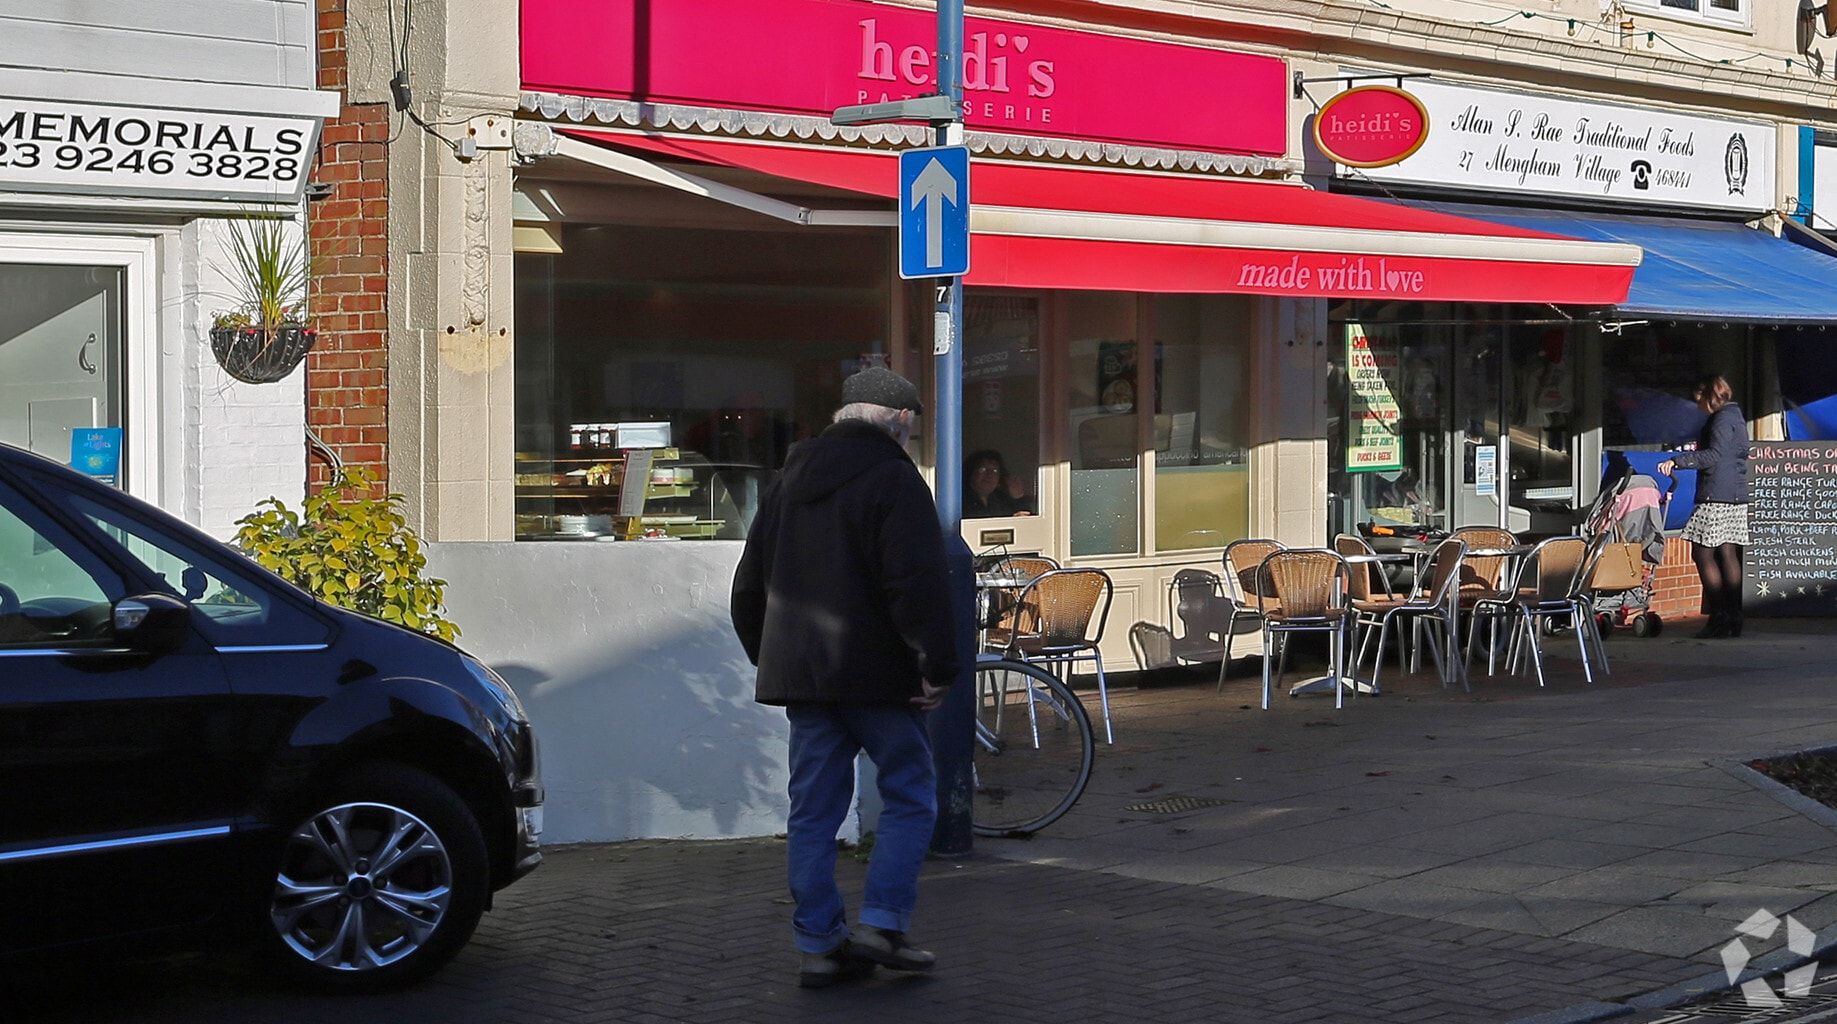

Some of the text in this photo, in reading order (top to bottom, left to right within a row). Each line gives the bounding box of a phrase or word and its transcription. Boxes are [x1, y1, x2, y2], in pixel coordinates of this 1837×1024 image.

[857, 19, 1055, 98] hedi's
[1330, 112, 1412, 134] heidi's
[1451, 104, 1494, 135] Alan
[1531, 112, 1563, 142] Rae
[1573, 117, 1653, 152] Traditional
[1658, 127, 1695, 157] Foods
[54, 144, 175, 175] 9246
[186, 153, 298, 181] 3828
[1459, 150, 1474, 172] 27
[1486, 143, 1562, 186] Mengham
[1573, 153, 1621, 194] Village
[1237, 255, 1311, 290] made
[1317, 257, 1373, 291] with
[936, 285, 947, 302] 7
[1352, 355, 1360, 367] IS
[1748, 446, 1820, 460] CHRISTMAS
[1755, 463, 1780, 474] NOW
[1784, 462, 1819, 475] BEING
[1755, 477, 1778, 487] FREE
[1781, 477, 1813, 489] RANGE
[1755, 488, 1777, 498] FREE
[1781, 488, 1813, 500] RANGE
[1755, 499, 1778, 509] FREE
[1781, 499, 1811, 510] RANGE
[1755, 510, 1780, 520] FREE
[1781, 510, 1810, 520] RANGE
[1754, 536, 1817, 546] FRESH STEAK
[1754, 548, 1787, 557] FRESH
[1759, 558, 1780, 566] AND
[1785, 557, 1811, 566] MUCH
[1759, 569, 1837, 579] FISH AVAILABLE
